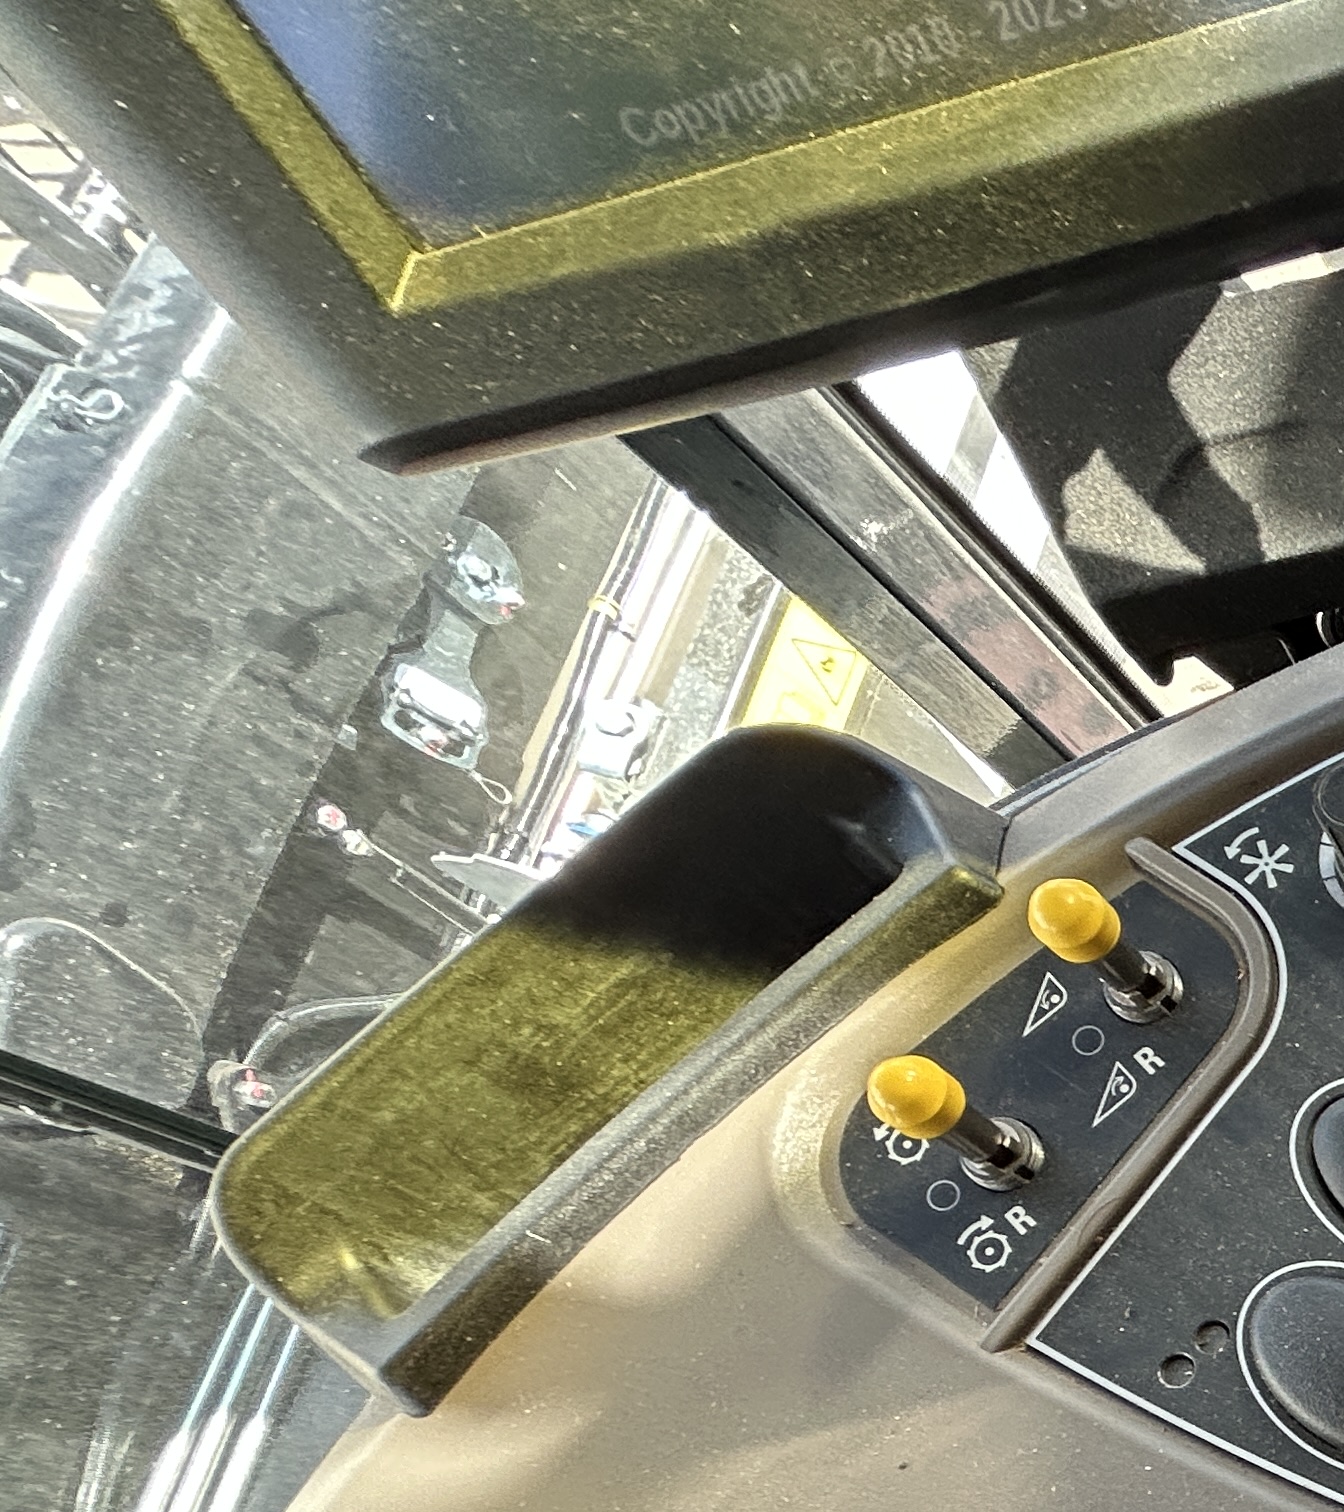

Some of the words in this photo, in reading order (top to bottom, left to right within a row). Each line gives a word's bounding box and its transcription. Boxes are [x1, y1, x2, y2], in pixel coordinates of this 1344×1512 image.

[618, 62, 820, 147] Copyright
[1133, 1046, 1166, 1076] R
[1004, 1204, 1037, 1236] R
